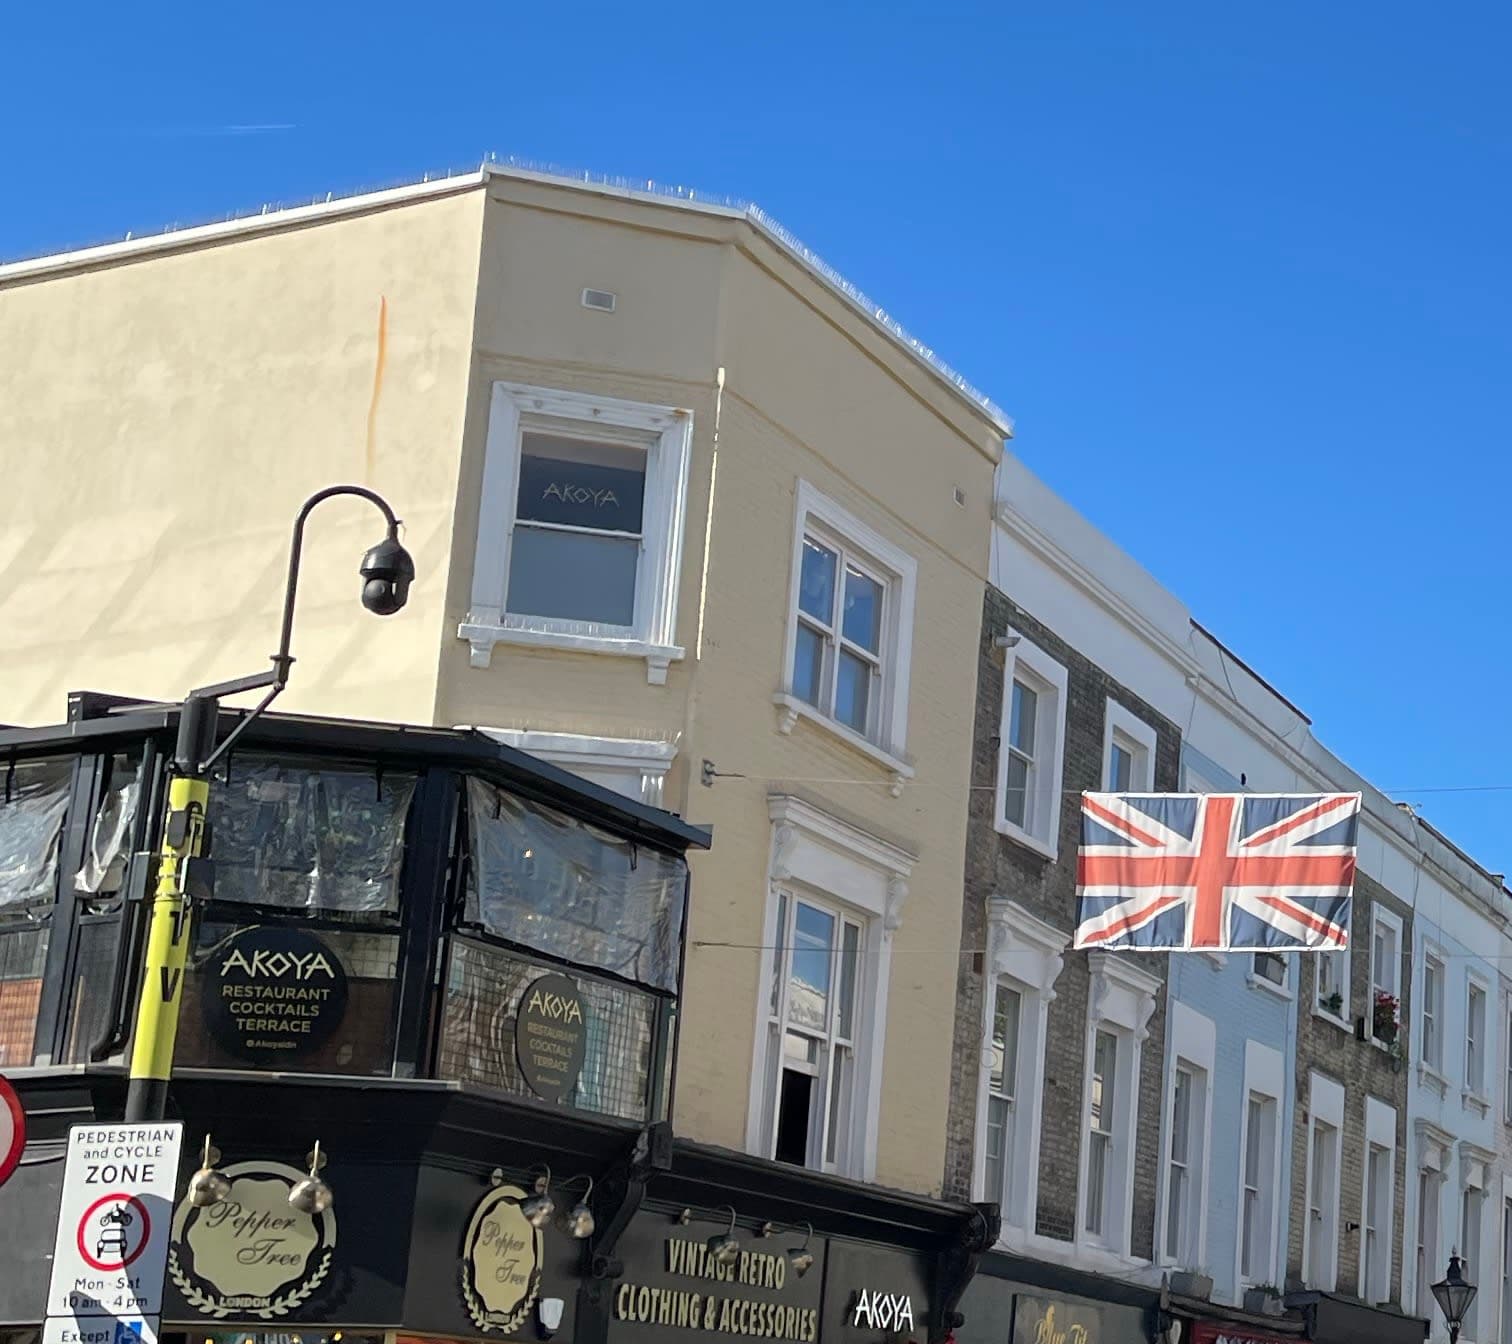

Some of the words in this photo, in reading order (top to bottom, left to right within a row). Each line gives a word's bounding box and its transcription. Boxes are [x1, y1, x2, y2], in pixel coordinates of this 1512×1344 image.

[542, 483, 620, 509] AKOYA
[220, 948, 336, 981] AKOYA
[222, 985, 331, 1001] RESTAURANT
[229, 1002, 320, 1017] COCKTAILS
[527, 989, 582, 1025] AKOYA
[236, 1018, 312, 1034] TERRACE
[529, 1038, 574, 1059] COCKTAILS
[533, 1054, 569, 1073] TERRACE
[77, 1129, 176, 1144] PEDESTRIAN
[83, 1147, 109, 1159] and
[114, 1146, 163, 1159] CYCLE
[85, 1164, 156, 1184] ZONE
[206, 1201, 297, 1239] Pepper
[482, 1220, 527, 1257] Pepper
[236, 1238, 302, 1266] Tree
[739, 1251, 786, 1291] RETRO
[74, 1278, 105, 1291] Mon
[117, 1277, 141, 1290] Sat
[219, 1297, 272, 1309] LONDON
[617, 1282, 701, 1329] CLOTHING
[703, 1295, 716, 1330] &
[718, 1298, 817, 1343] ACCESSORIES
[854, 1288, 914, 1332] AKOYA
[61, 1330, 110, 1344] Except
